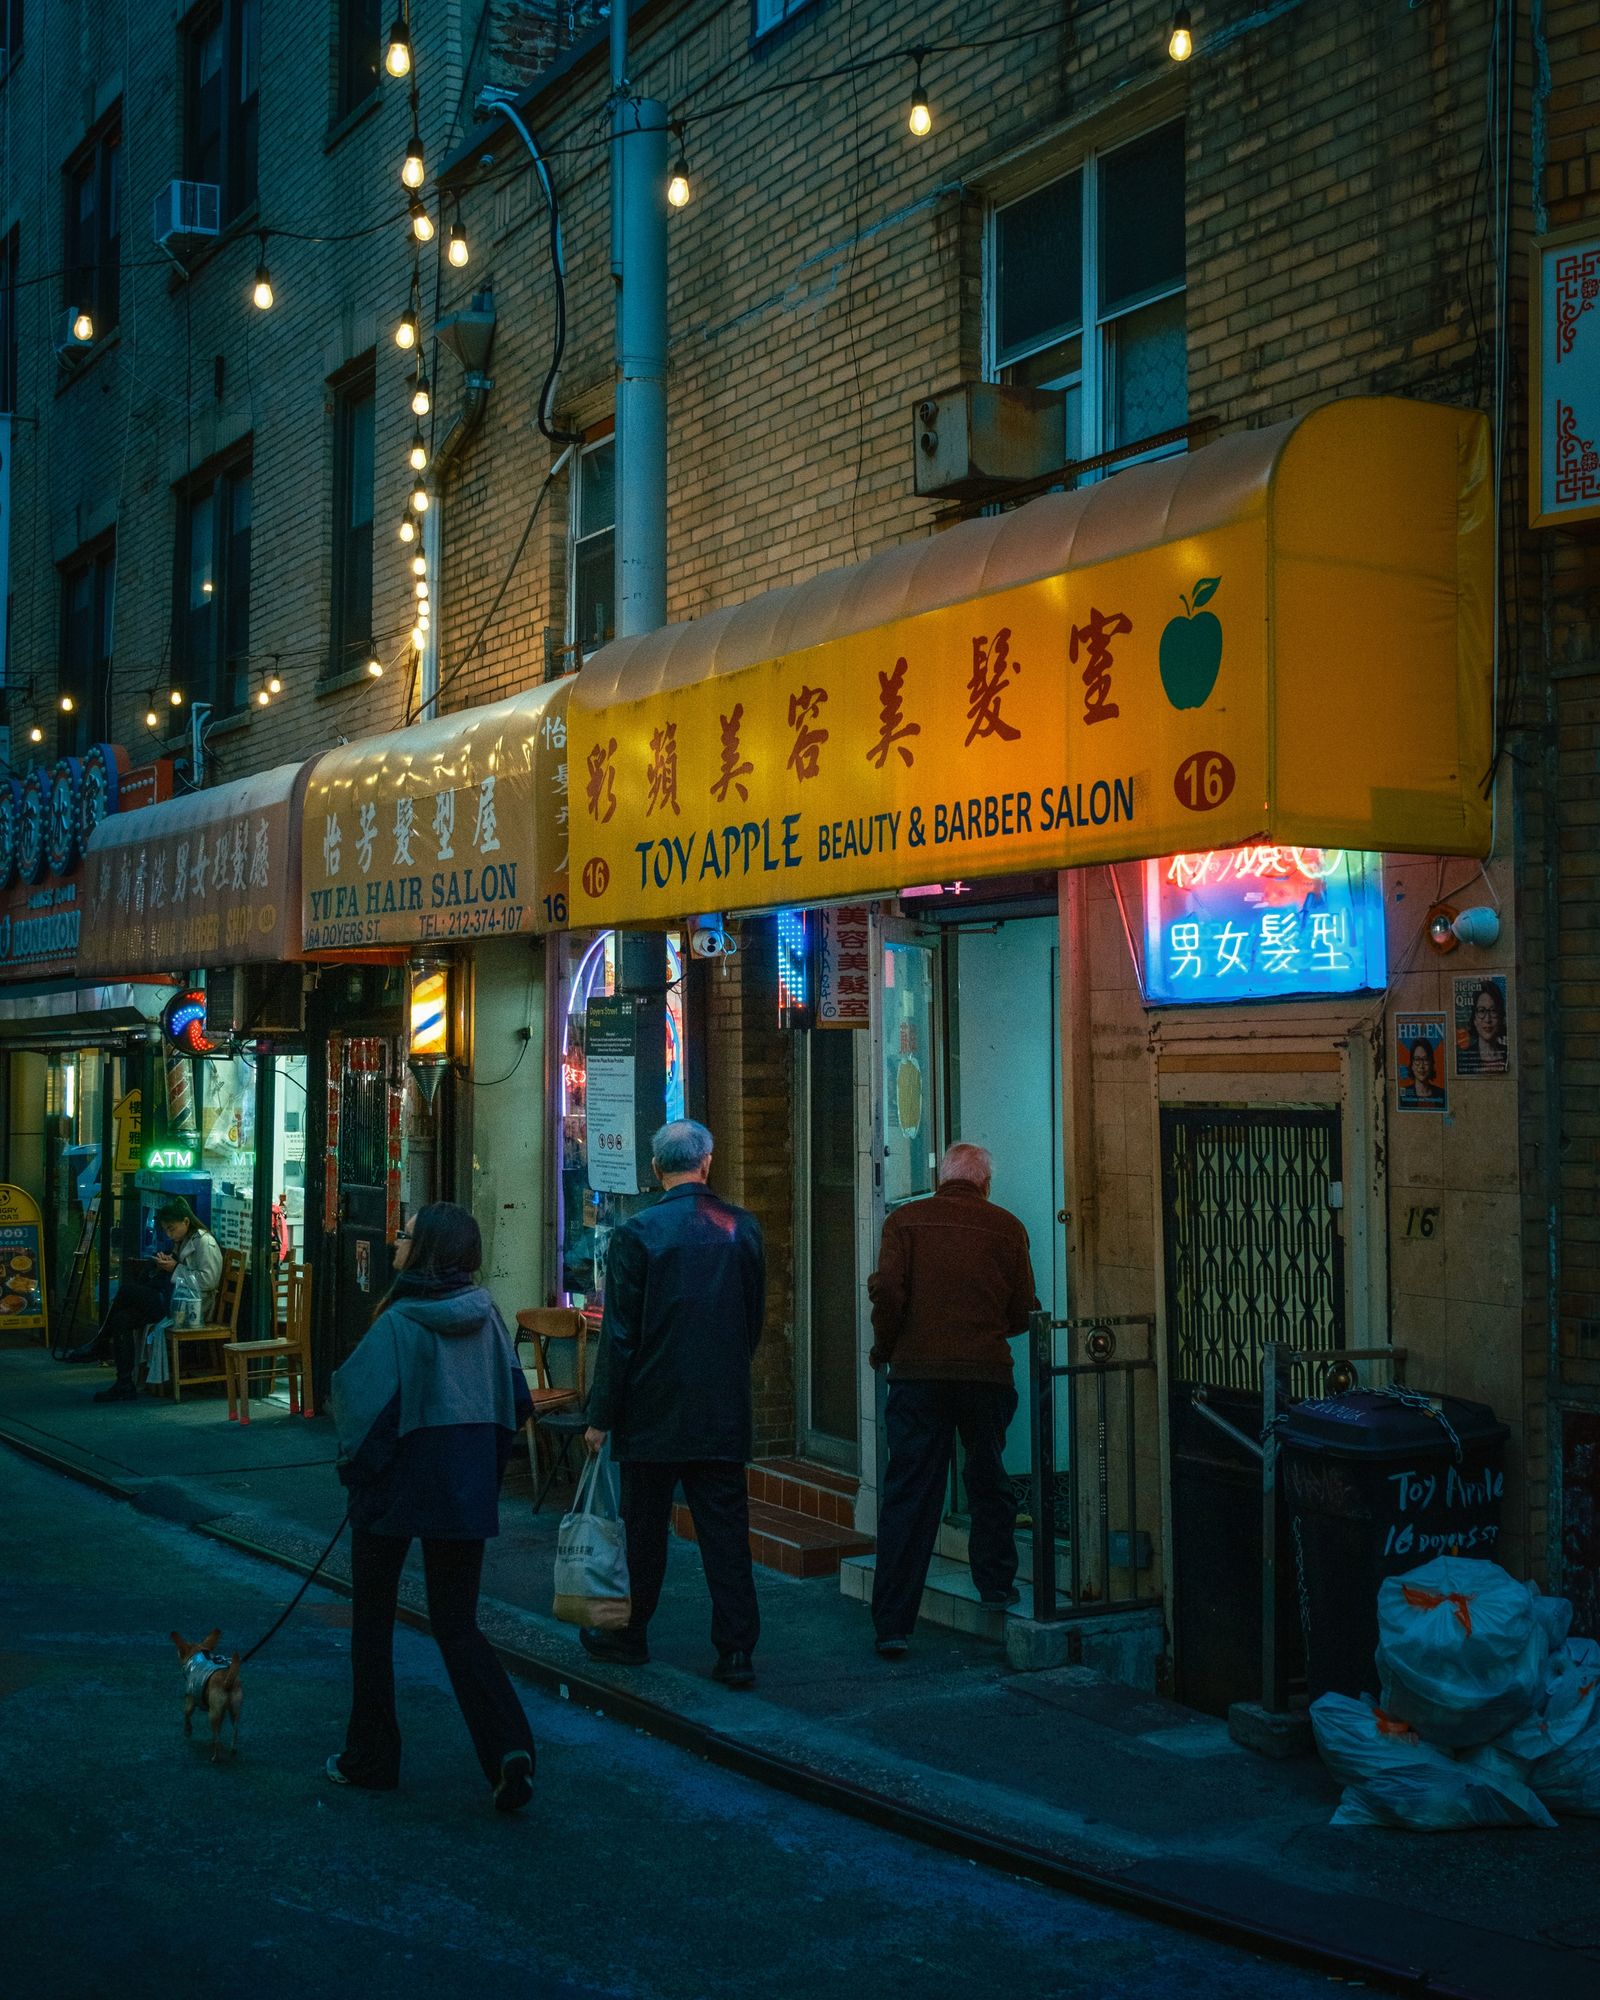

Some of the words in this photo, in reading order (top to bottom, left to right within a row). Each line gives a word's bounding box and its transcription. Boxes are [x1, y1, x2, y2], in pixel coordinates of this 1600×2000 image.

[1184, 757, 1223, 806] 16
[635, 832, 697, 892] TOY
[699, 812, 803, 882] APPLE
[818, 811, 902, 862] BEAUTY
[908, 806, 926, 848] &
[934, 791, 1032, 845] BARBER
[1041, 776, 1134, 831] SALON
[366, 876, 424, 915] HAIR
[432, 863, 518, 909] SALON
[587, 861, 606, 895] 16
[543, 893, 567, 922] 16
[225, 904, 252, 947] SHOP
[322, 922, 364, 945] DOYERS
[1169, 912, 1350, 980] 男女髮型
[1398, 1022, 1445, 1039] HELEN
[149, 1150, 193, 1168] ATM
[1406, 1208, 1434, 1237] 16
[1387, 1470, 1437, 1513] Toy
[1384, 1522, 1414, 1557] 16
